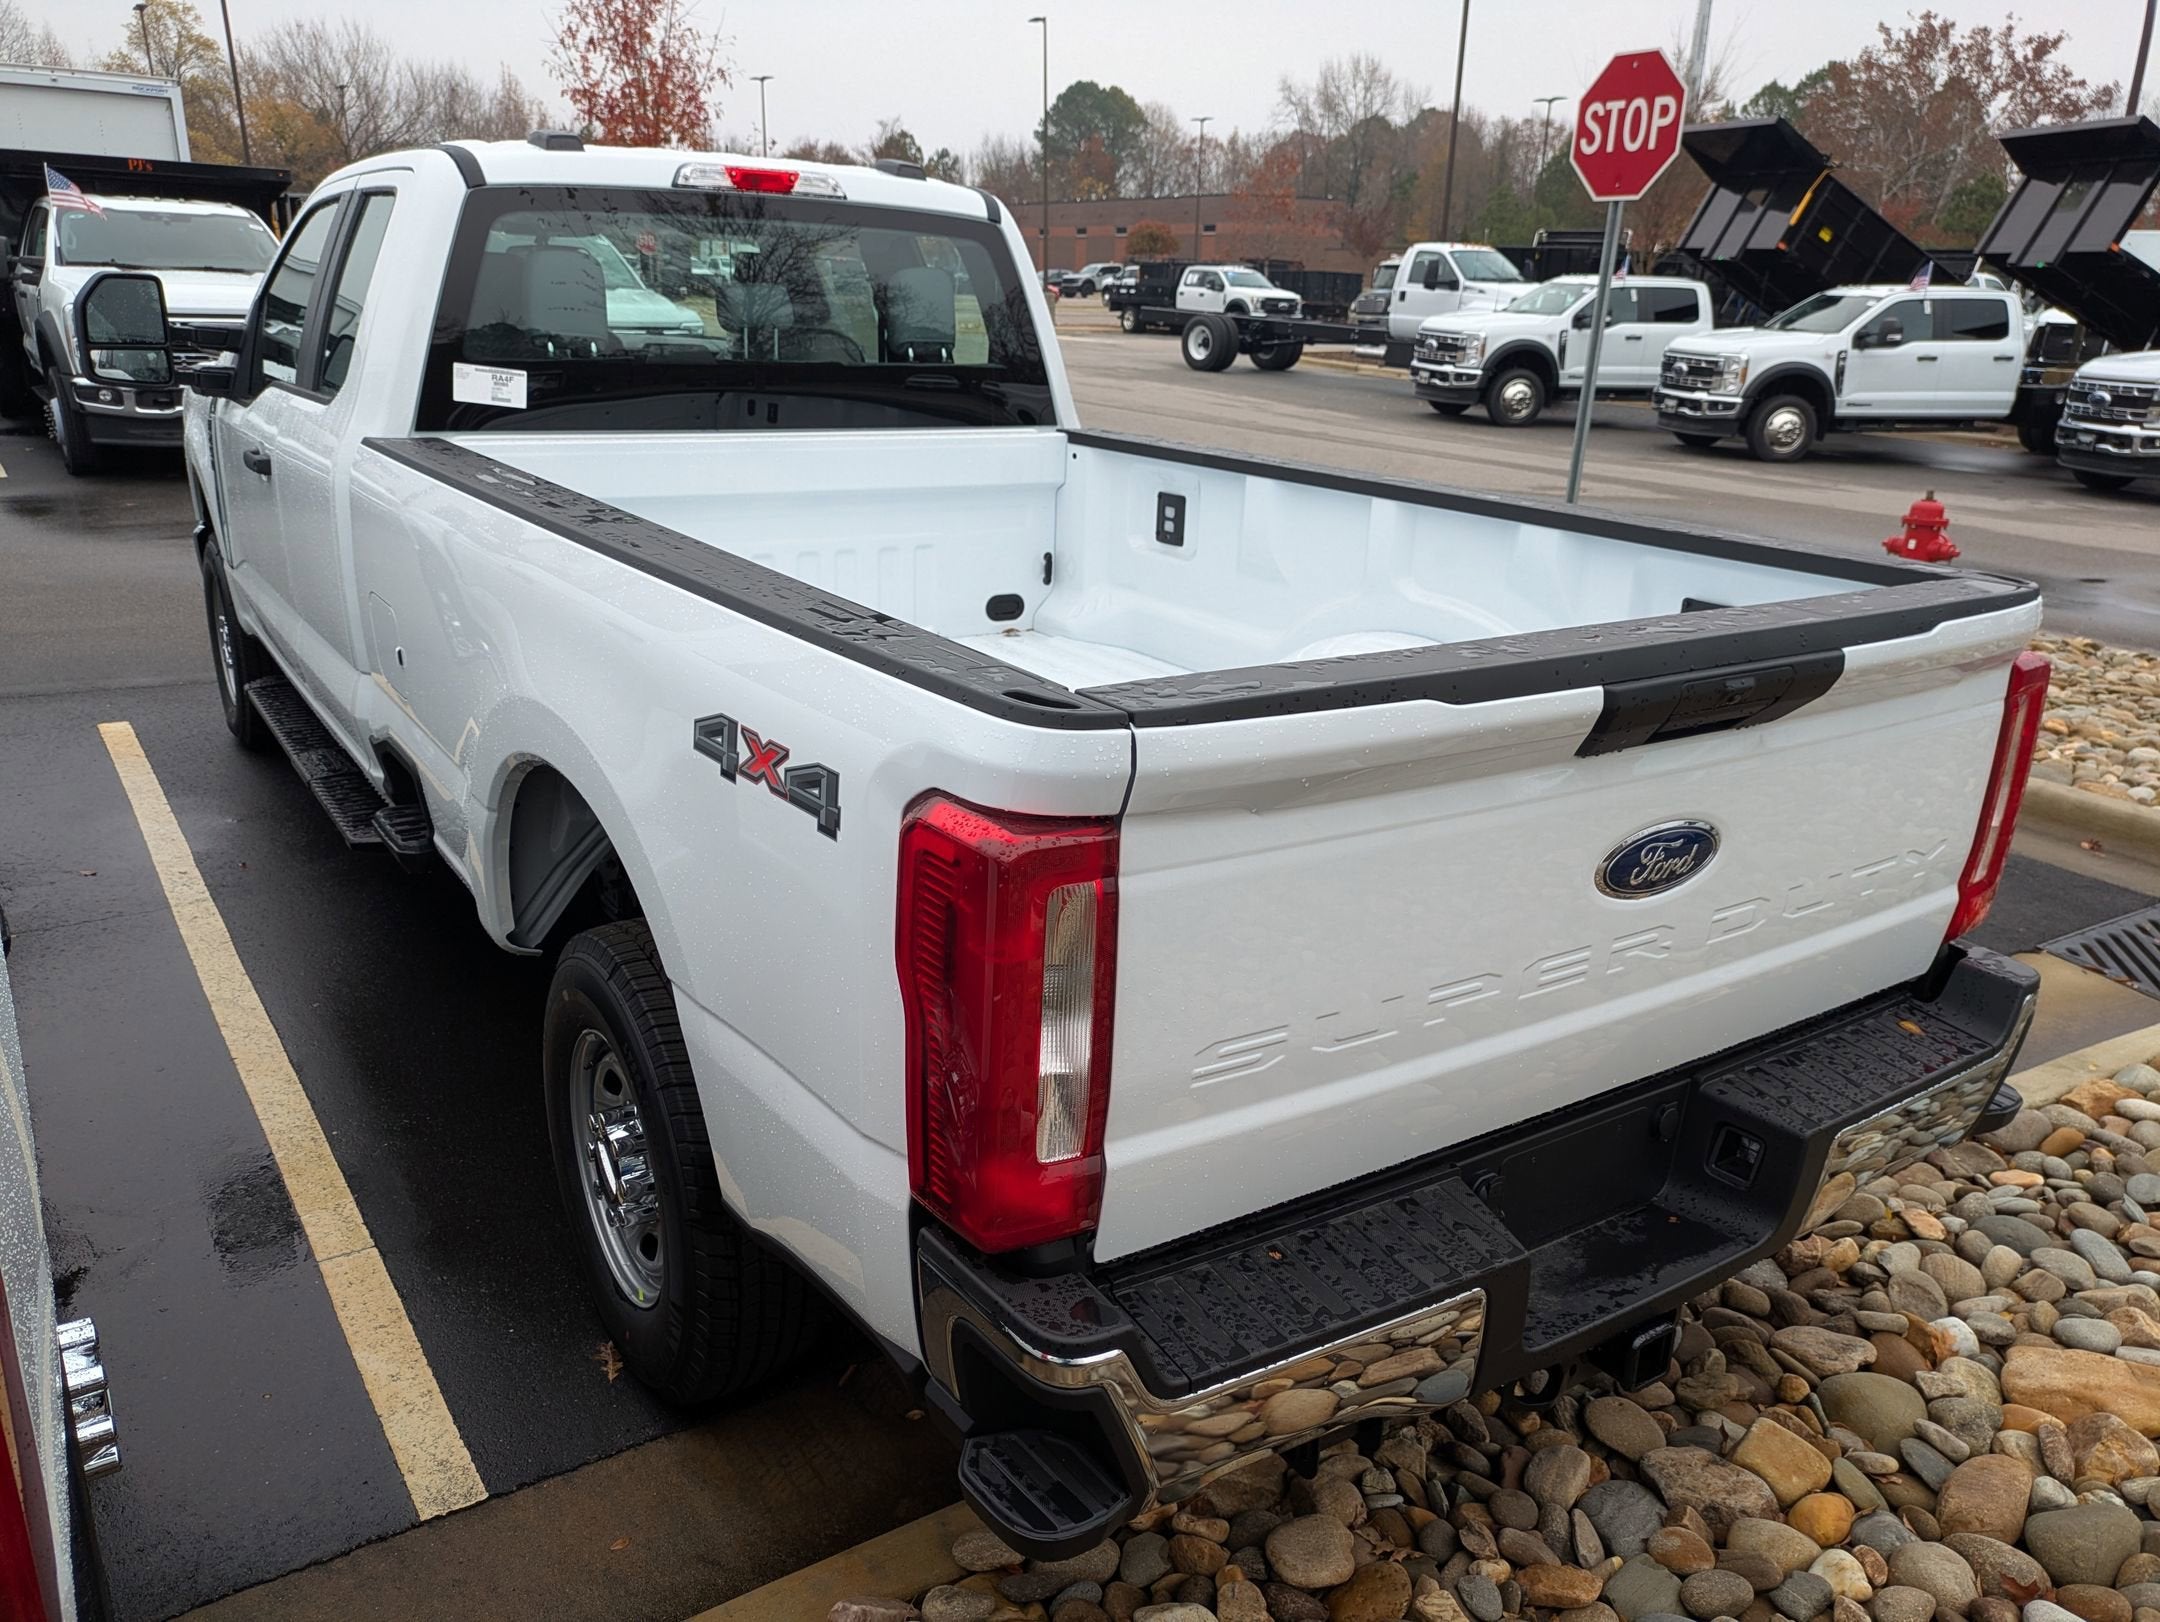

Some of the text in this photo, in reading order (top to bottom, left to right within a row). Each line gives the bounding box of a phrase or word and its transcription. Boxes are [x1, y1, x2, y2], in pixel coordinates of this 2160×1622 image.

[1579, 95, 1677, 155] STOP
[491, 374, 514, 383] RA4F
[1629, 838, 1699, 886] Ford
[1190, 838, 1948, 1089] SUPER DUTY
